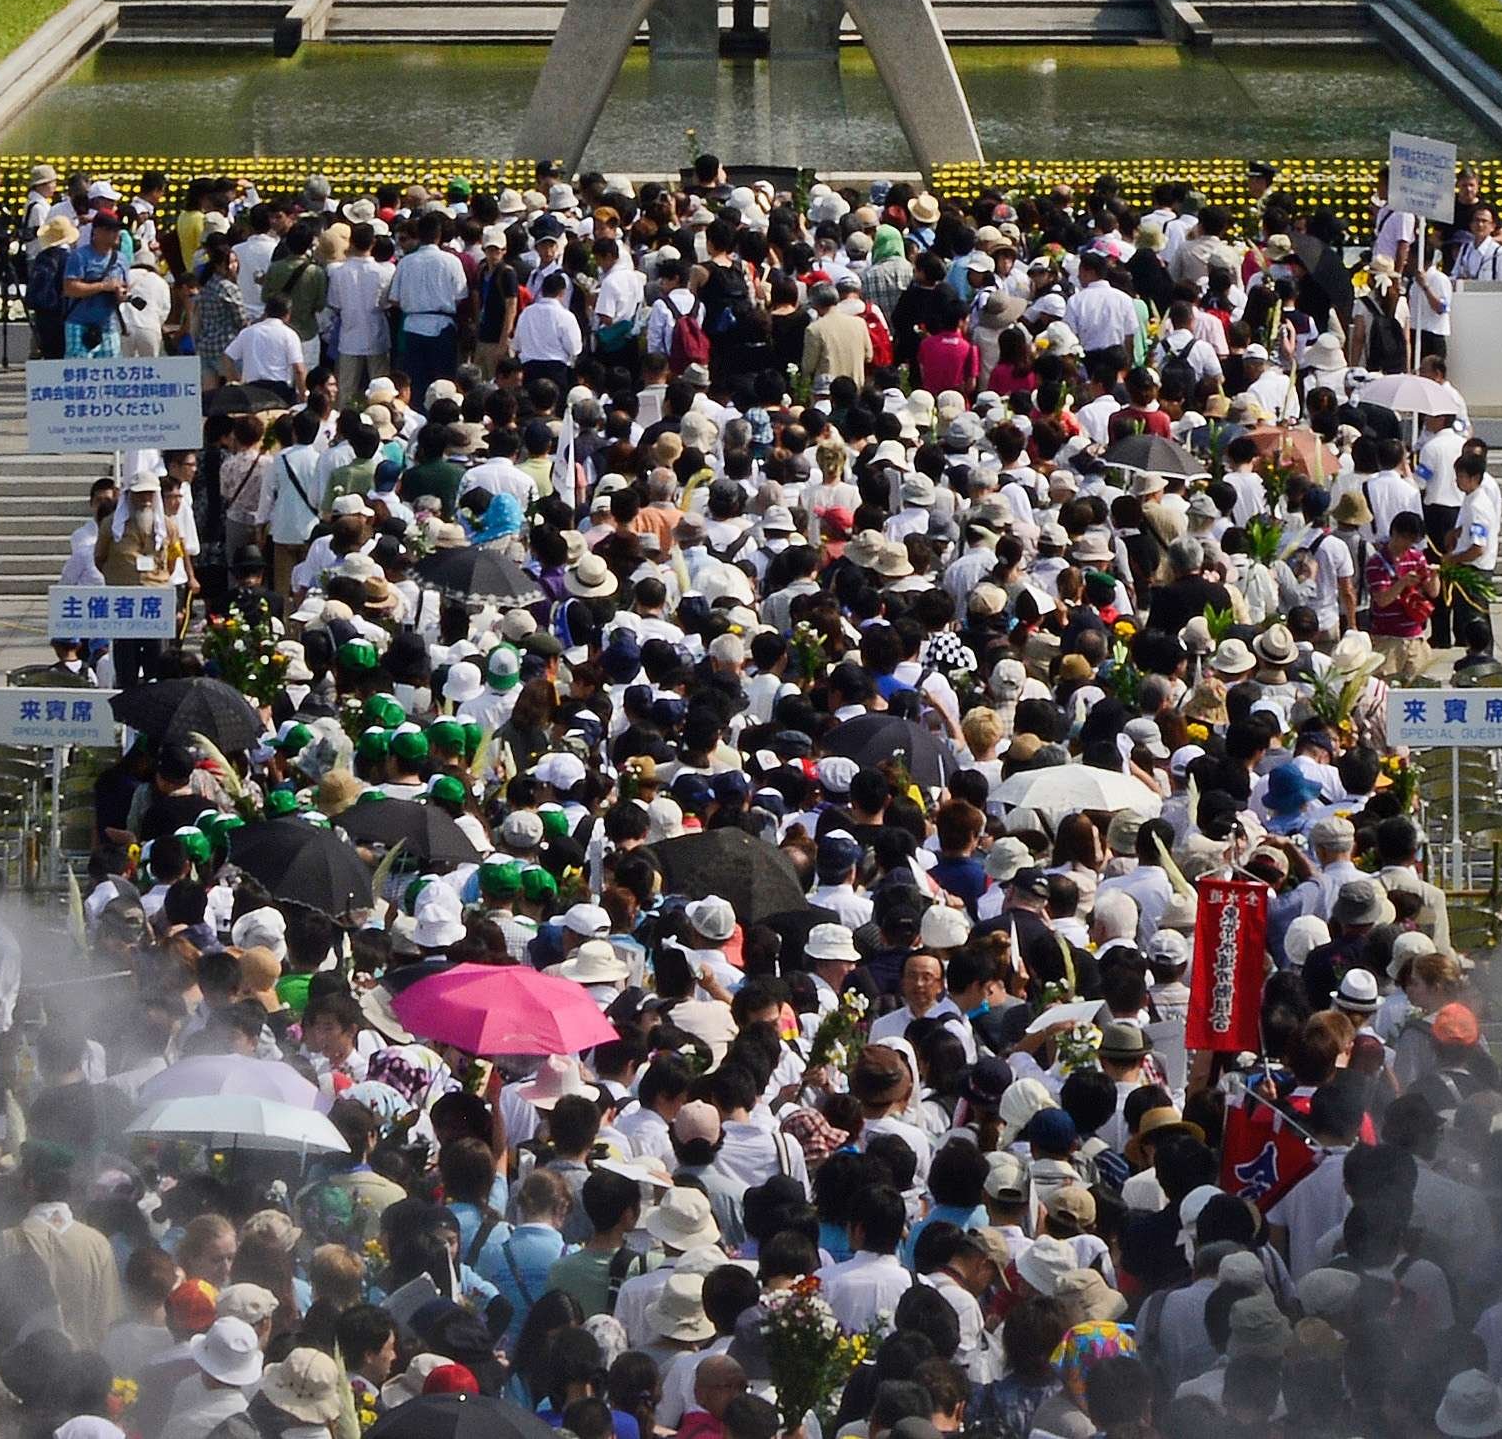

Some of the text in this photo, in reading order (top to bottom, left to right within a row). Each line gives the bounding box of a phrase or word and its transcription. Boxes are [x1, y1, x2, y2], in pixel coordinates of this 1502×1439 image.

[63, 366, 161, 382] 参拝される方は、
[64, 403, 165, 419] おまわりください
[61, 596, 163, 619] 主催者席
[20, 700, 93, 722] 来賓席
[12, 727, 99, 738] SPECIAL GUESTS
[1401, 728, 1455, 739] SPECIAL
